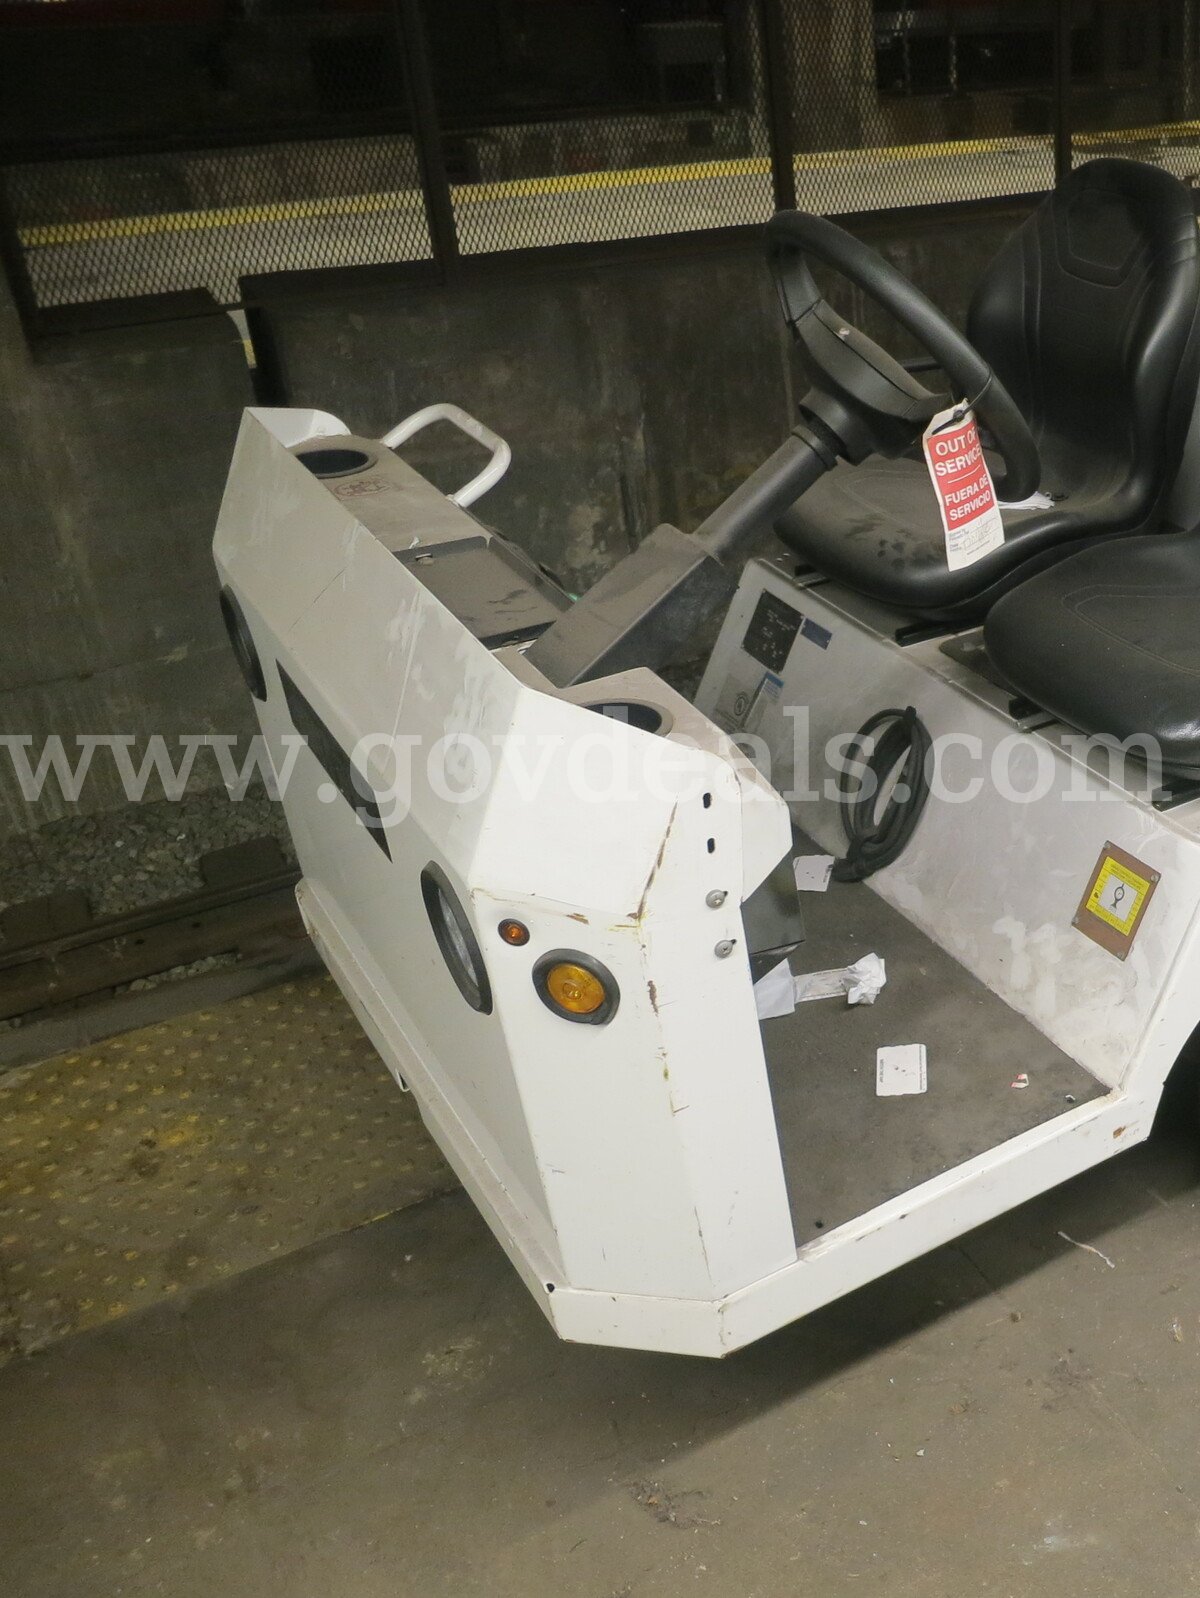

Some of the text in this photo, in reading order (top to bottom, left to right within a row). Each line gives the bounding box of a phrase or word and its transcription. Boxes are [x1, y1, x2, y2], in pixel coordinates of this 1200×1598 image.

[934, 443, 981, 476] SERVICE
[935, 435, 966, 456] OUT
[945, 473, 989, 506] FUERA DE
[949, 489, 991, 521] SERVICIO
